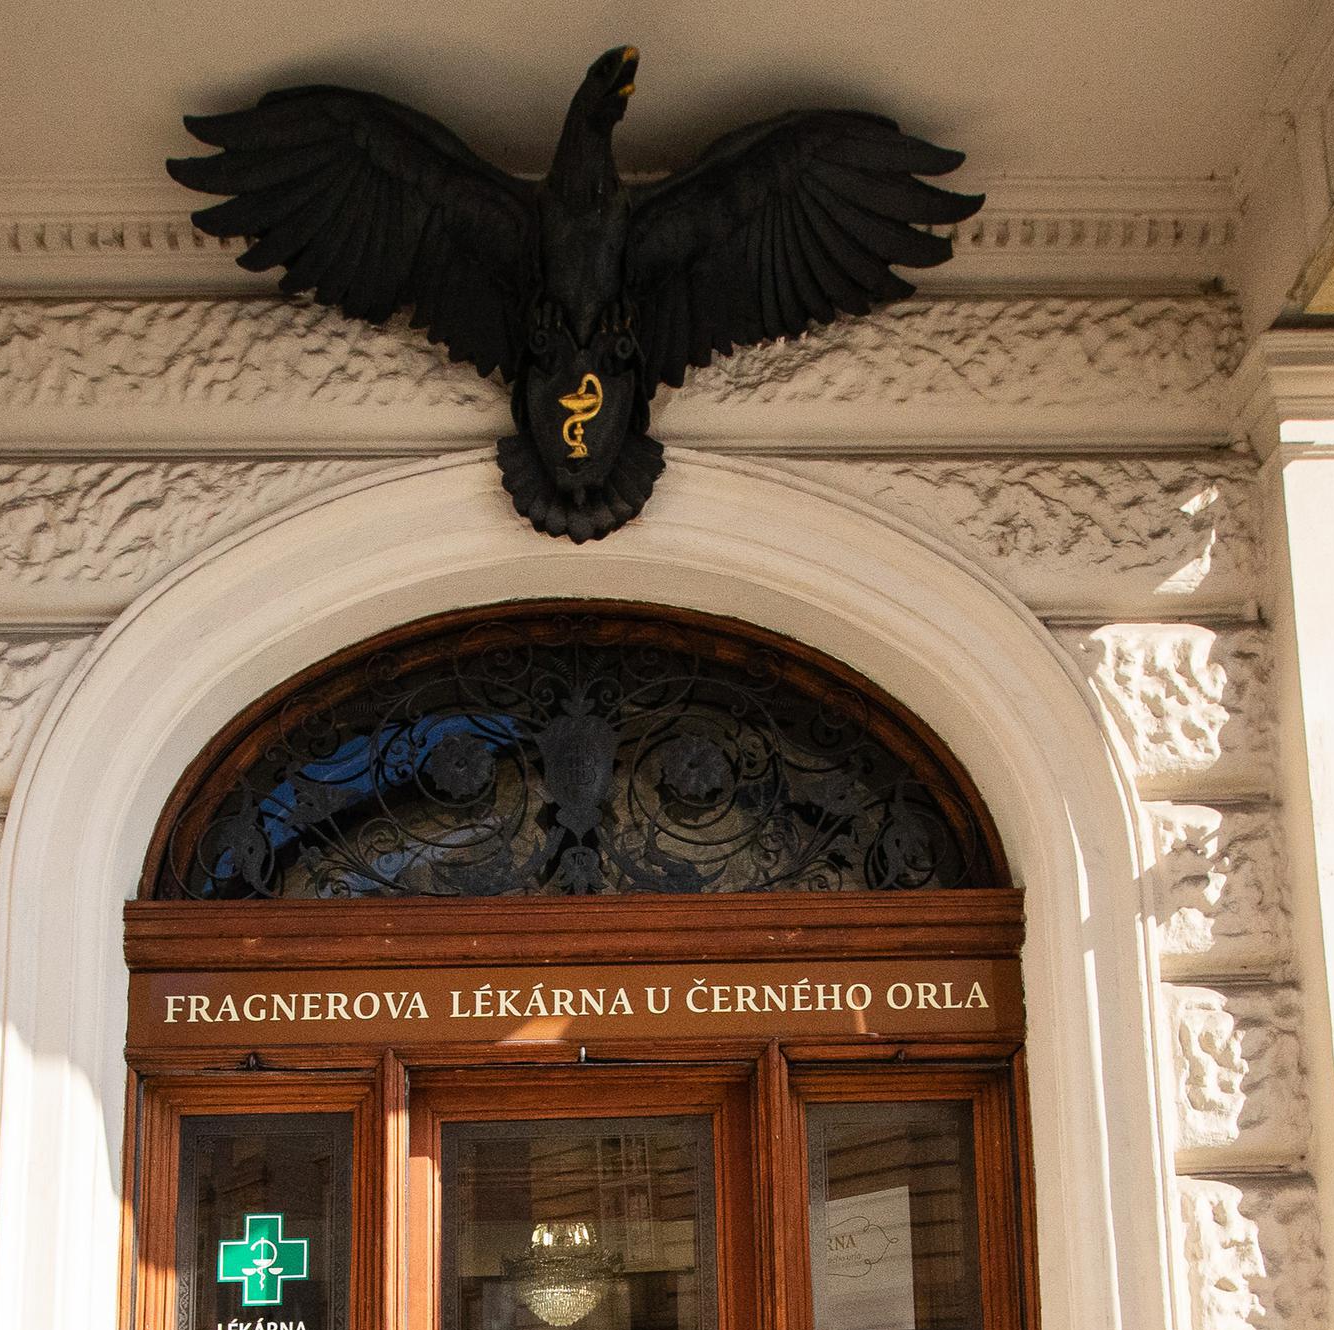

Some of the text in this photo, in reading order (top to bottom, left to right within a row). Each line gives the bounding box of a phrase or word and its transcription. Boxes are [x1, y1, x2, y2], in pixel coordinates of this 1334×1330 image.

[164, 977, 990, 1023] FRAGNEROVA LÉKÁRNA U ČERNÉHO ORLA
